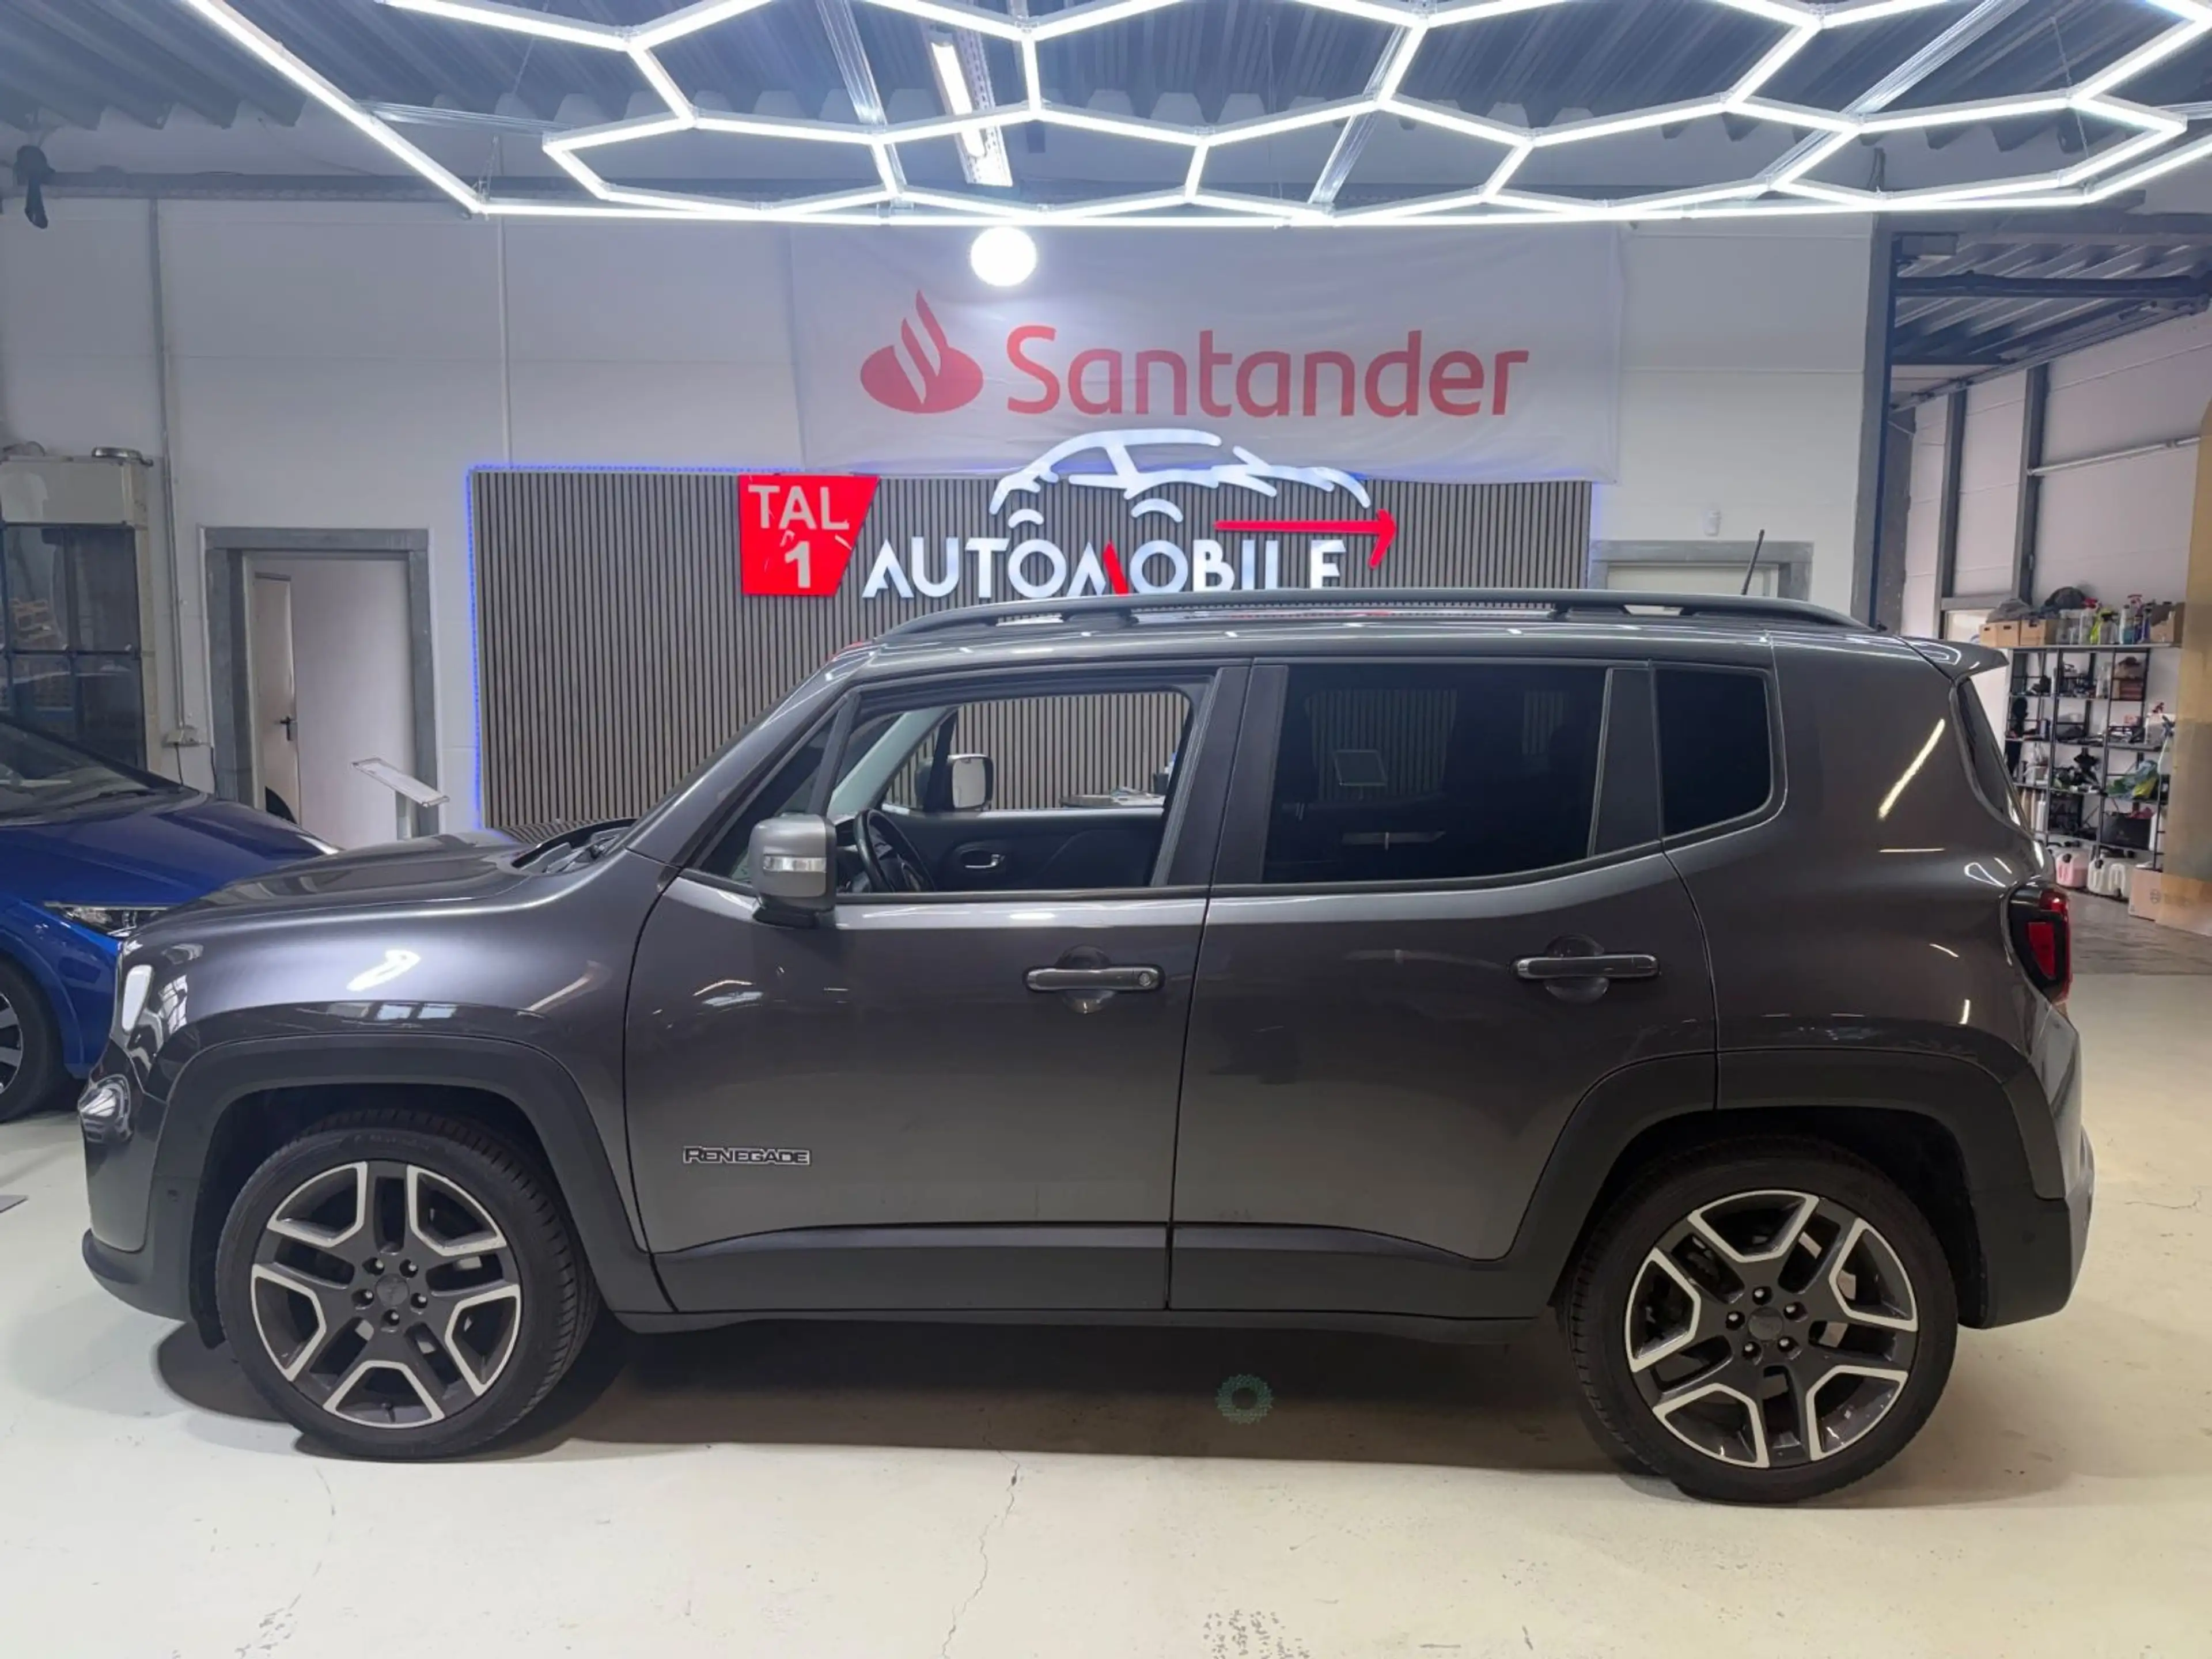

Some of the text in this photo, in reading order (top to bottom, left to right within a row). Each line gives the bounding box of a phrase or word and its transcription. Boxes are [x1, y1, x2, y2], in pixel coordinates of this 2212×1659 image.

[1006, 325, 1529, 418] Santander
[748, 484, 850, 529] TAL
[784, 540, 811, 588] 1
[683, 1146, 810, 1165] RENEGADE
